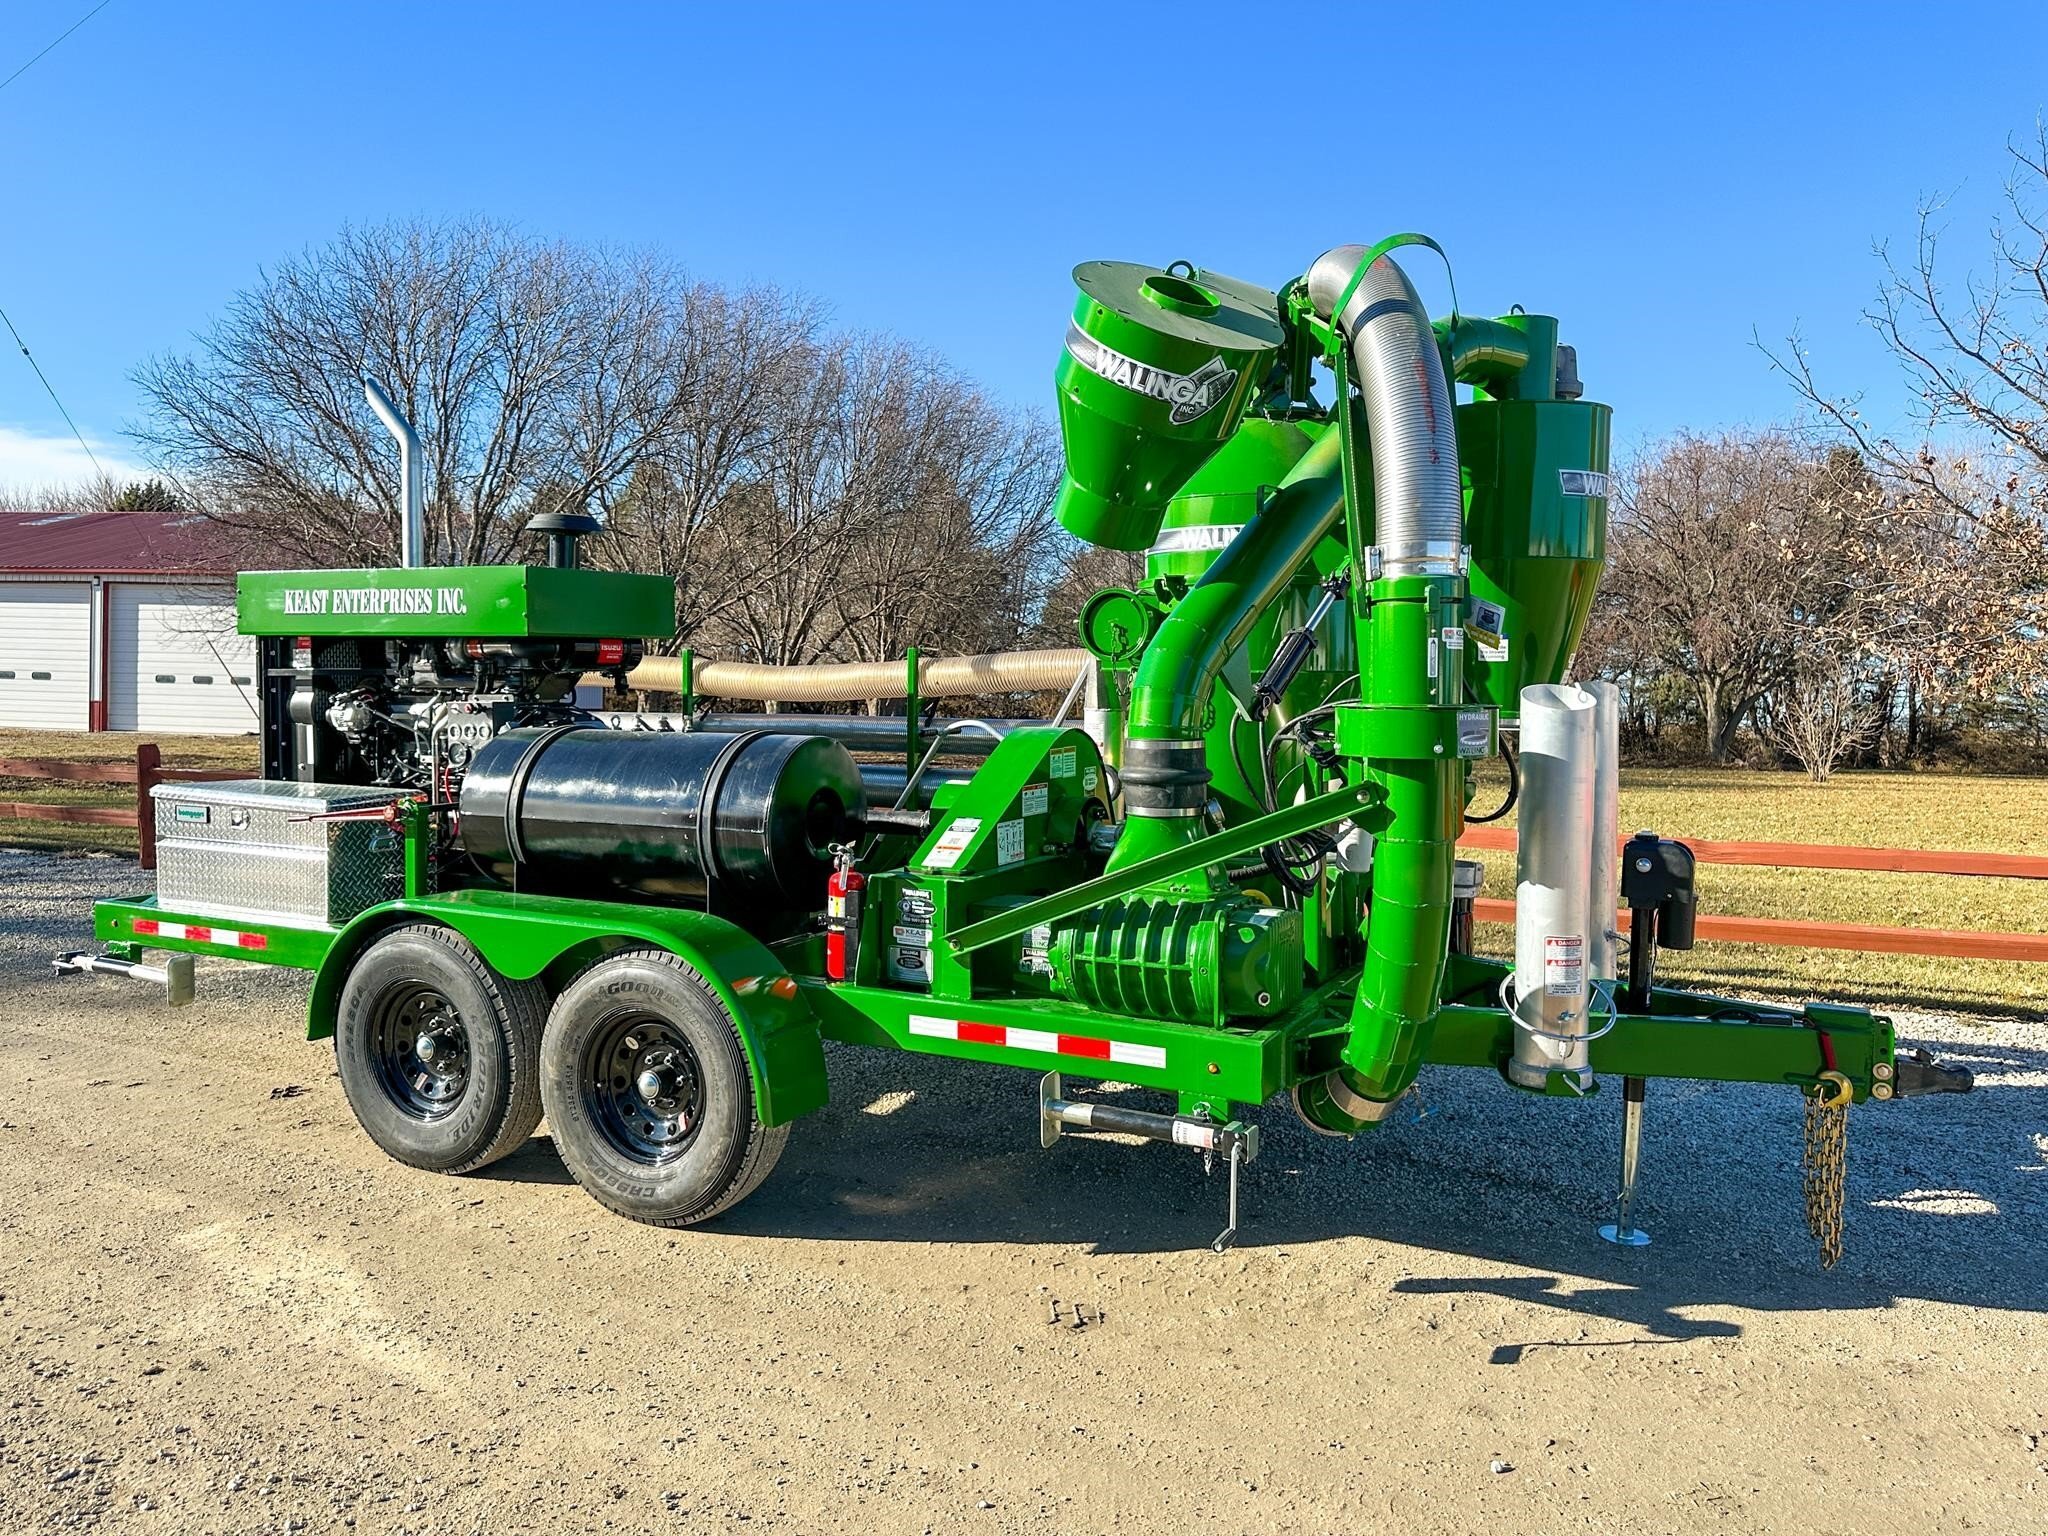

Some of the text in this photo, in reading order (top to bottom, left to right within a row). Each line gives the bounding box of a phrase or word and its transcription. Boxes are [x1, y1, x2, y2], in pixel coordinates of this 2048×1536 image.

[1096, 347, 1209, 407] WALINGA
[283, 587, 467, 615] KEAST ENTERPRISES INC.
